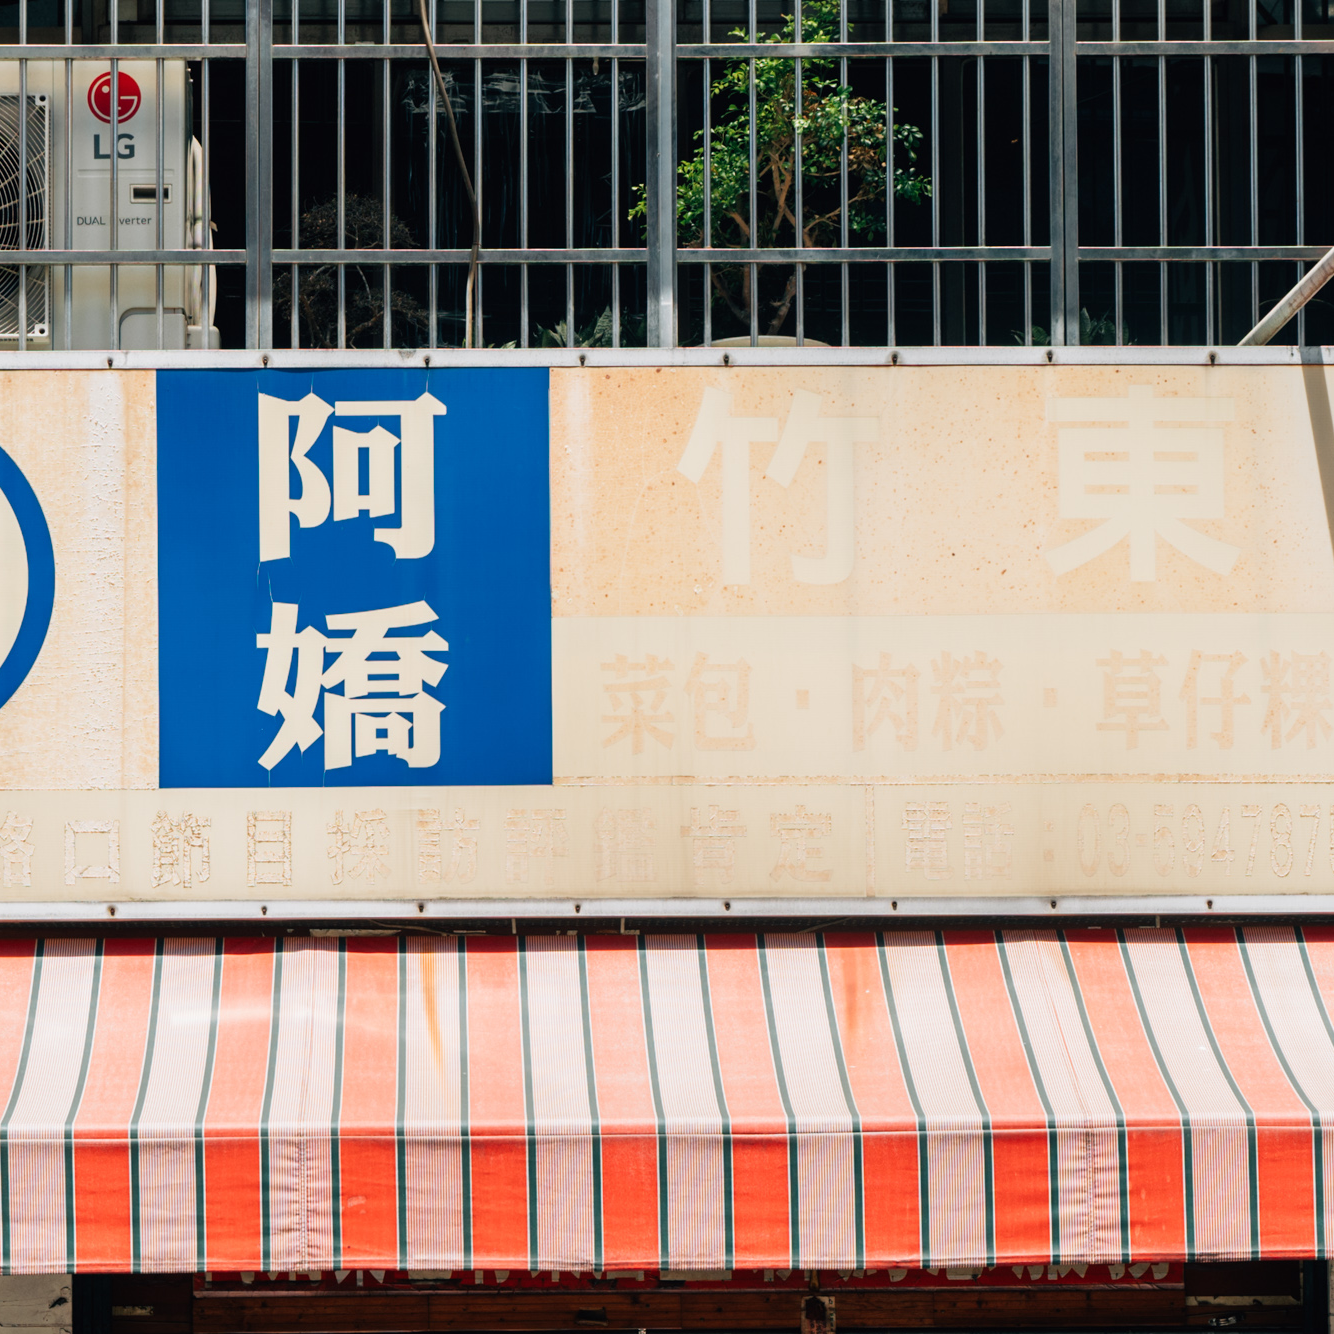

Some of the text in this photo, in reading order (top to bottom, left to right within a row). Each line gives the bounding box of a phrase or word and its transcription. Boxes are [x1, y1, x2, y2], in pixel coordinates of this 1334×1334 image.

[93, 133, 136, 160] LG
[77, 216, 106, 226] DUAL
[257, 391, 449, 772] 阿嬌
